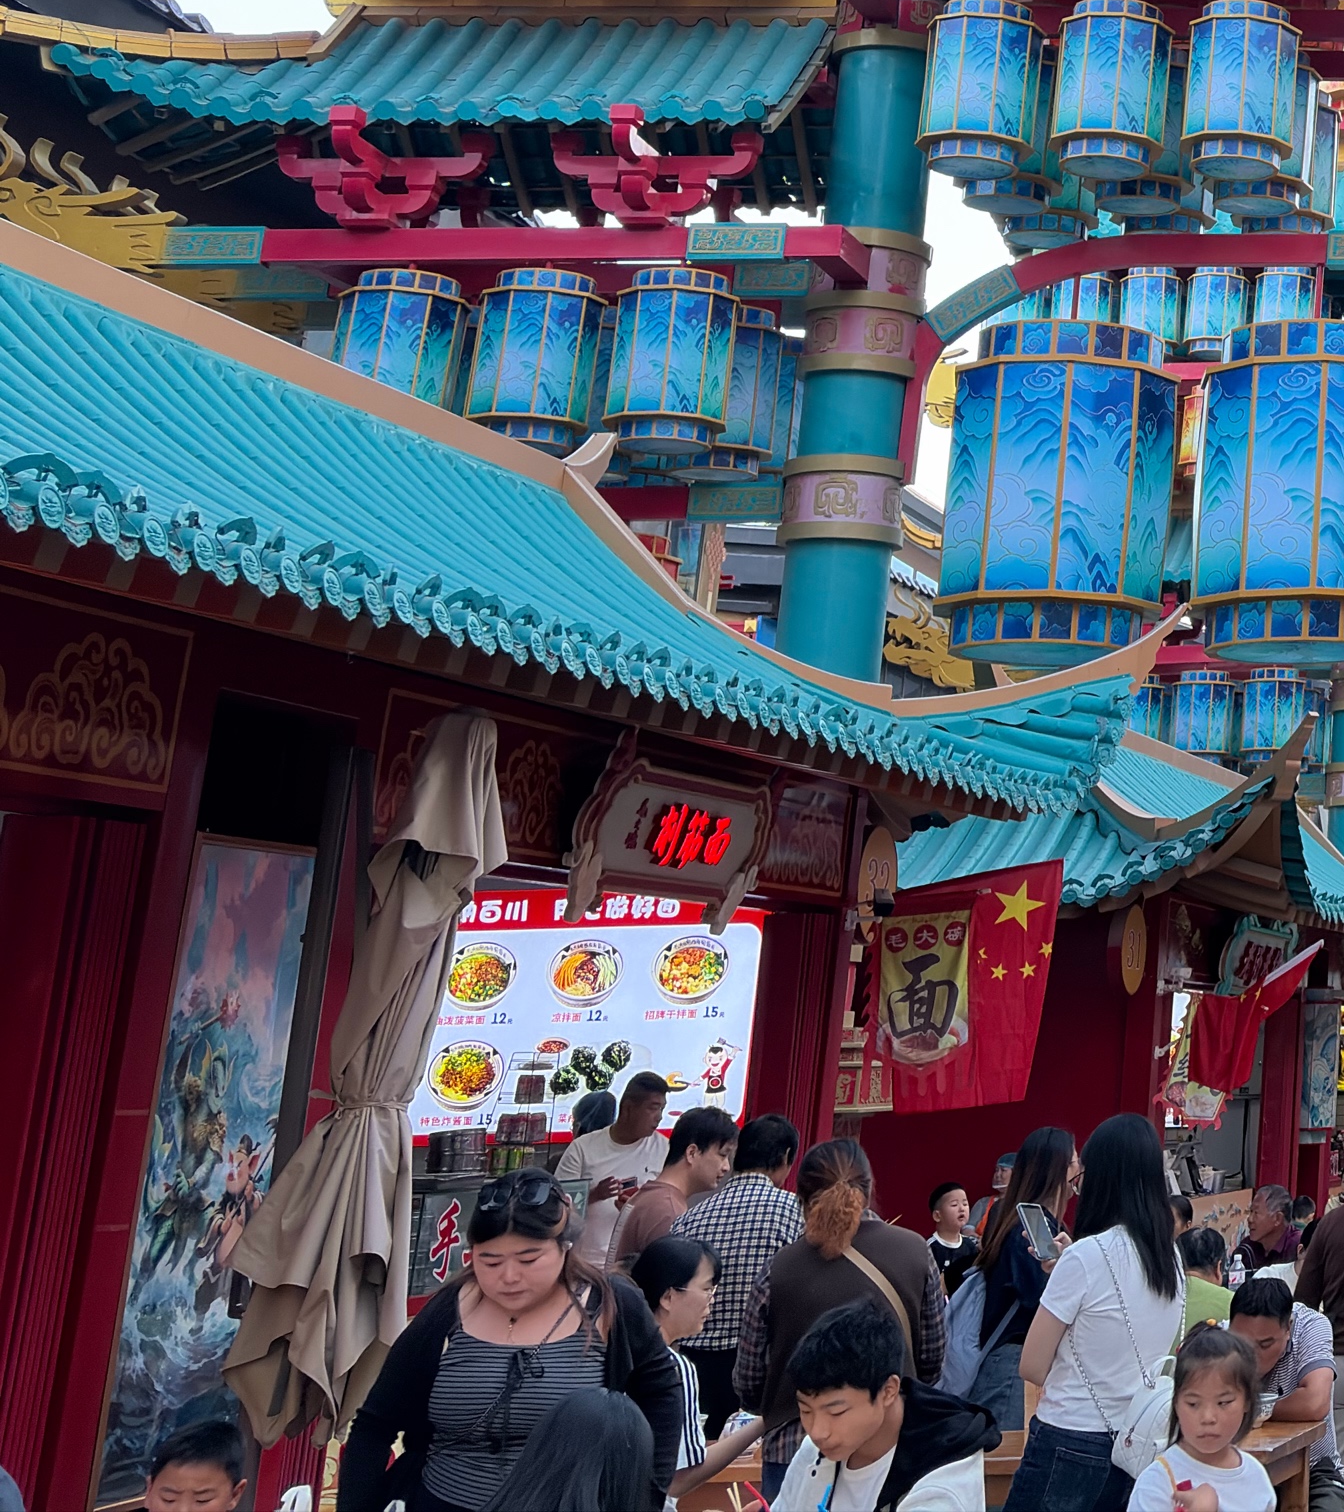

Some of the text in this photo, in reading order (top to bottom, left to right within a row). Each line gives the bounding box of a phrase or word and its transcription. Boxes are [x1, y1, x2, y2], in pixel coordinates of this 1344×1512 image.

[886, 926, 964, 947] 毛大碗
[1127, 928, 1141, 970] 31
[887, 953, 959, 1039] 面
[551, 1012, 581, 1023] 凉拌面
[645, 1009, 697, 1020] 招牌干拌面
[420, 1116, 472, 1126] 特色炸酱面
